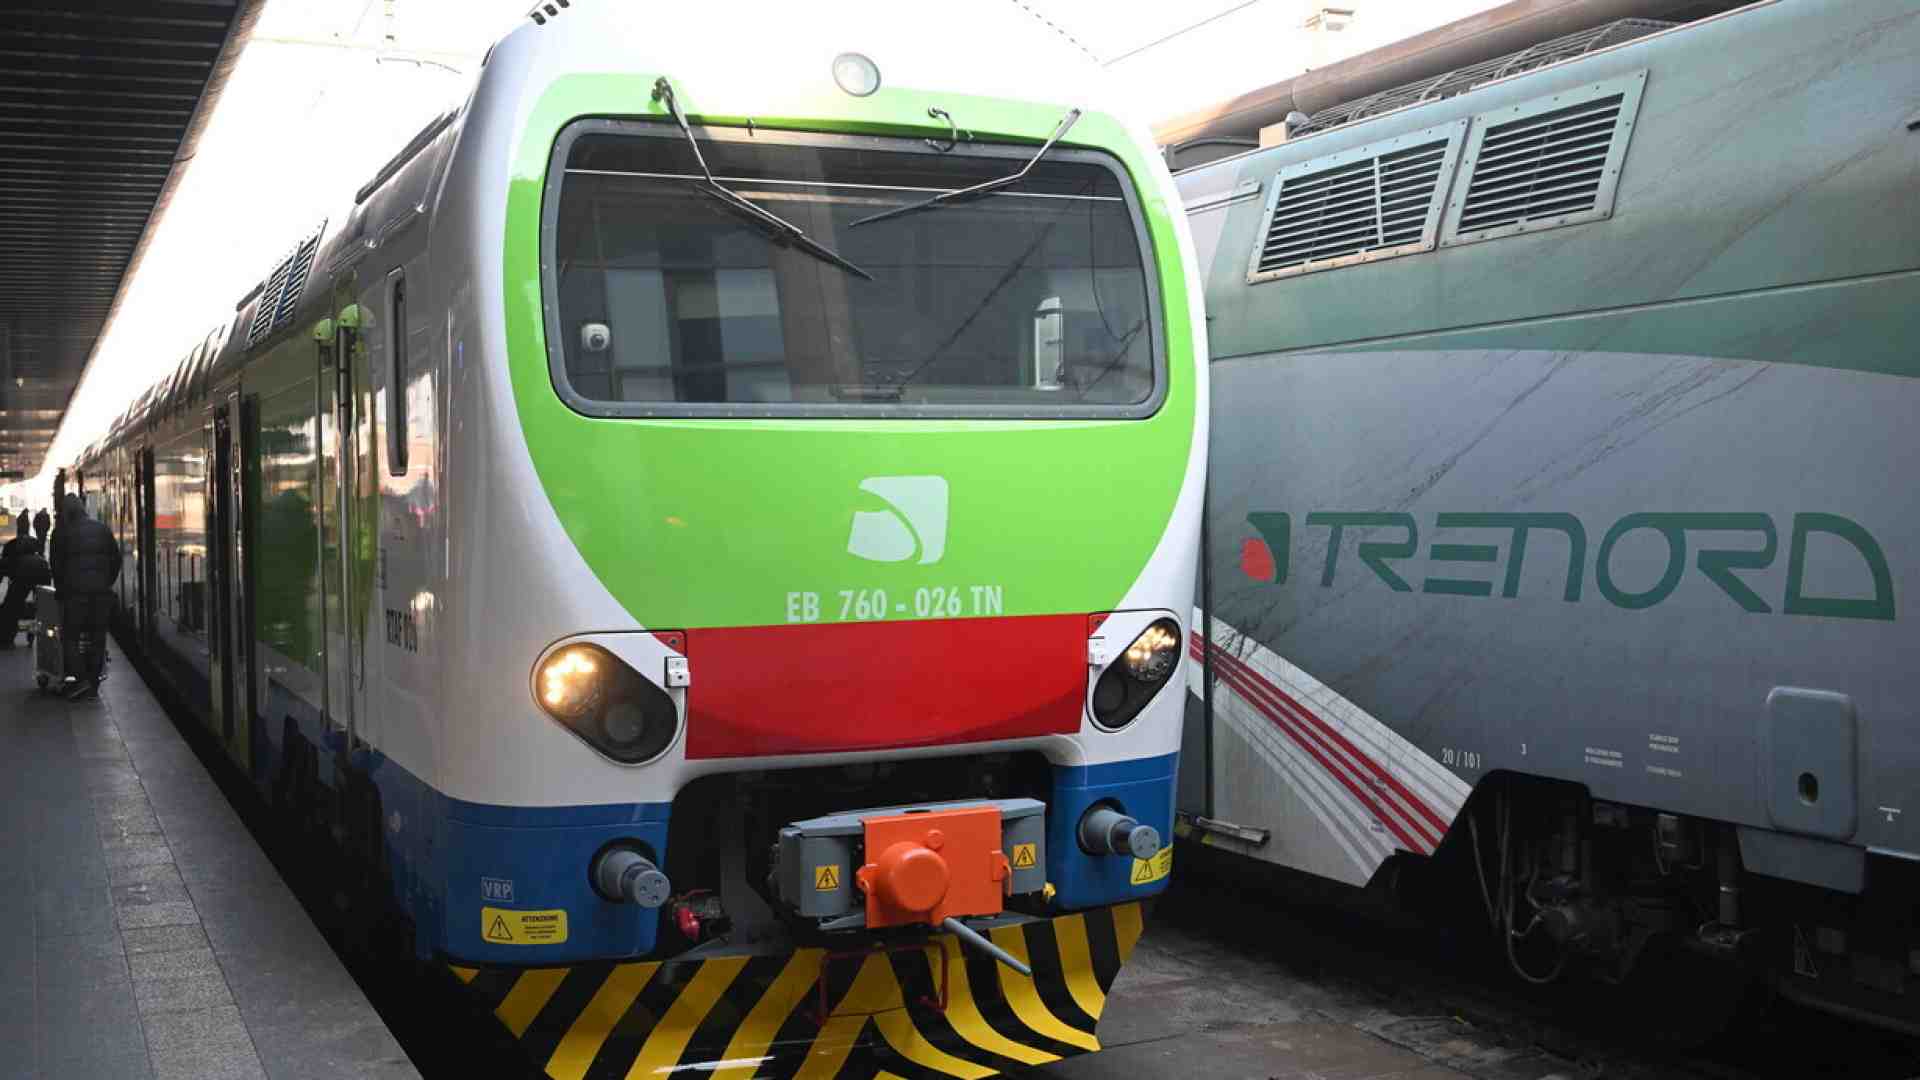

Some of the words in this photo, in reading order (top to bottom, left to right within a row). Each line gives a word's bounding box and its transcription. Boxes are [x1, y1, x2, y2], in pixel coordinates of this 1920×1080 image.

[1304, 511, 1896, 621] TRENORD
[787, 591, 819, 622] EB
[838, 589, 887, 620] 760
[895, 603, 907, 613] -
[915, 586, 961, 617] 026
[970, 585, 1003, 615] TN
[1442, 747, 1455, 765] 20
[1464, 751, 1481, 769] 101
[483, 881, 511, 898] VRP
